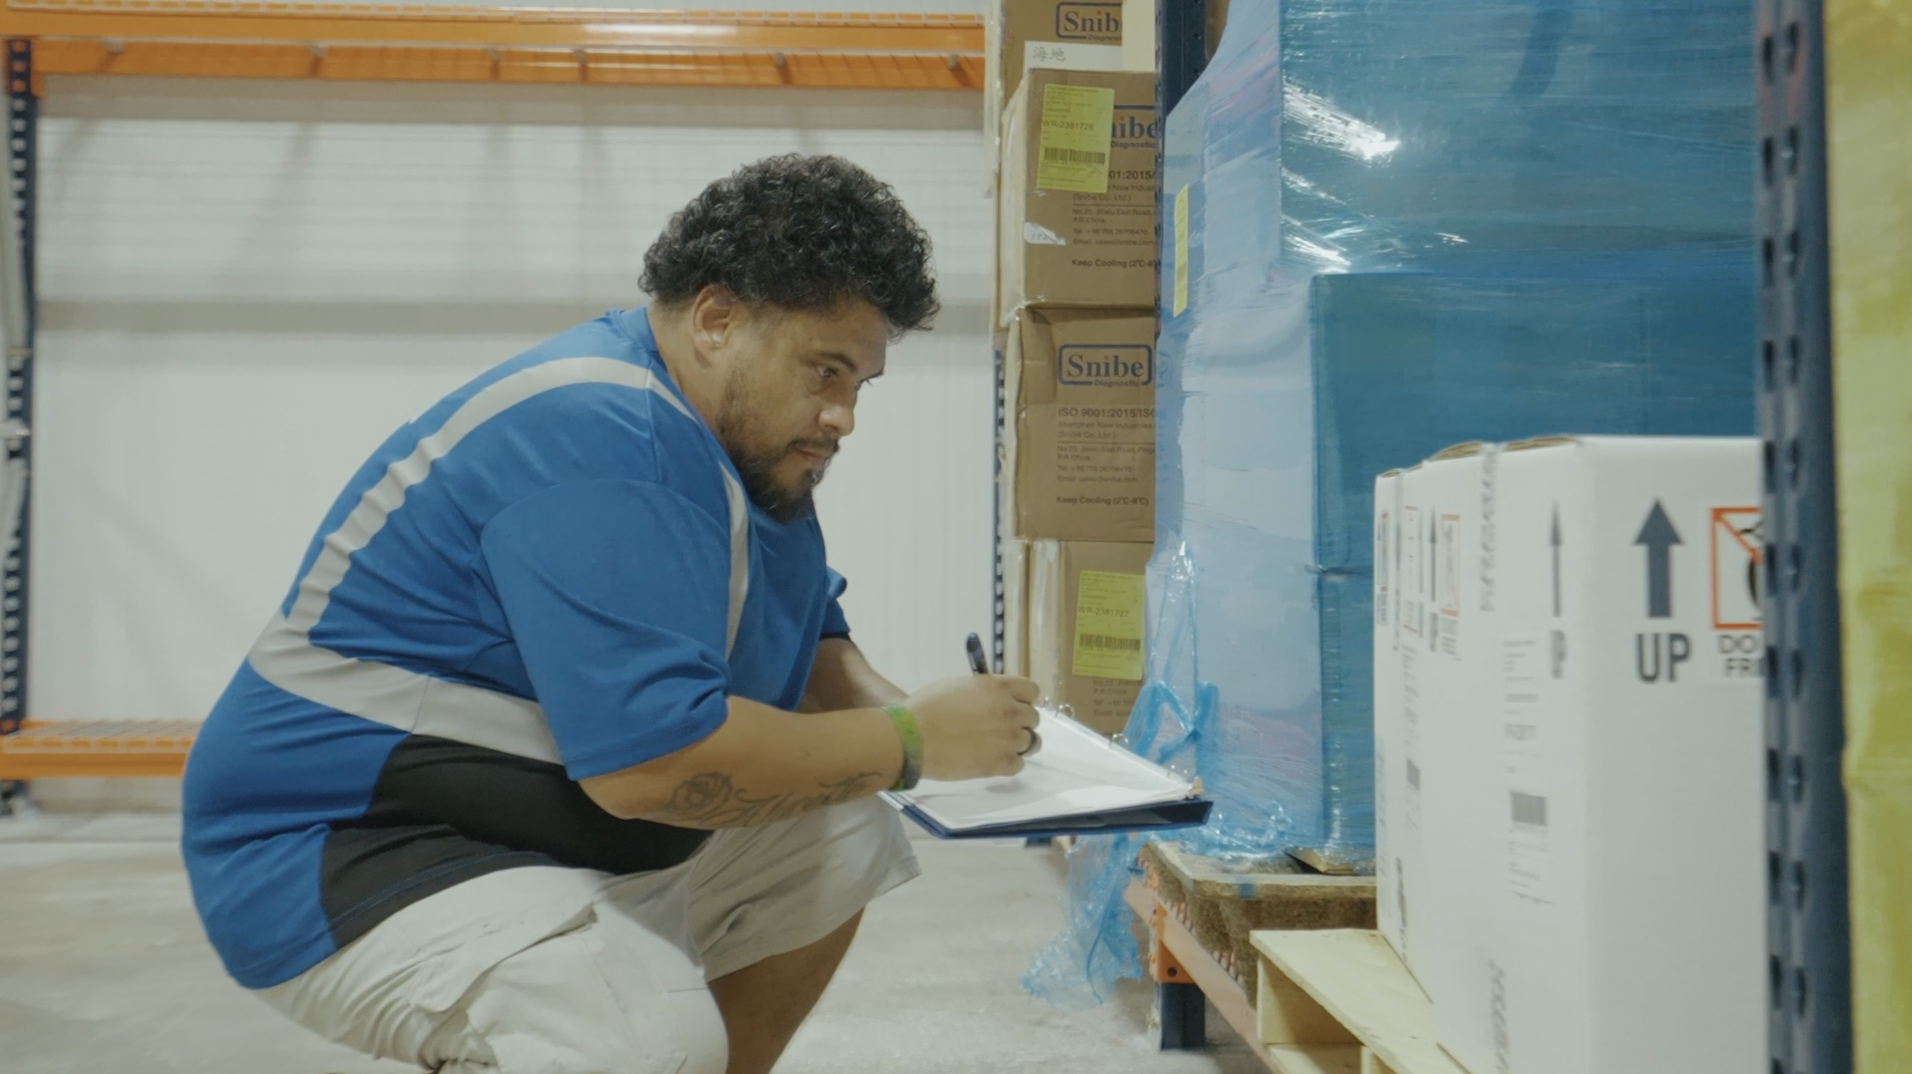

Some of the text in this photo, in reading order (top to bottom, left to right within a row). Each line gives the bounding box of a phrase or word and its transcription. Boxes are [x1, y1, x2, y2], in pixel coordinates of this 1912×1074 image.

[1064, 10, 1120, 32] Snib
[1072, 259, 1093, 268] Keep
[1095, 258, 1127, 269] Cooling
[1067, 353, 1144, 377] Snibe
[1058, 407, 1078, 417] ISO
[1056, 496, 1078, 505] Keep
[1079, 496, 1111, 506] Cooling
[1718, 634, 1757, 654] DO
[1636, 633, 1690, 684] UP
